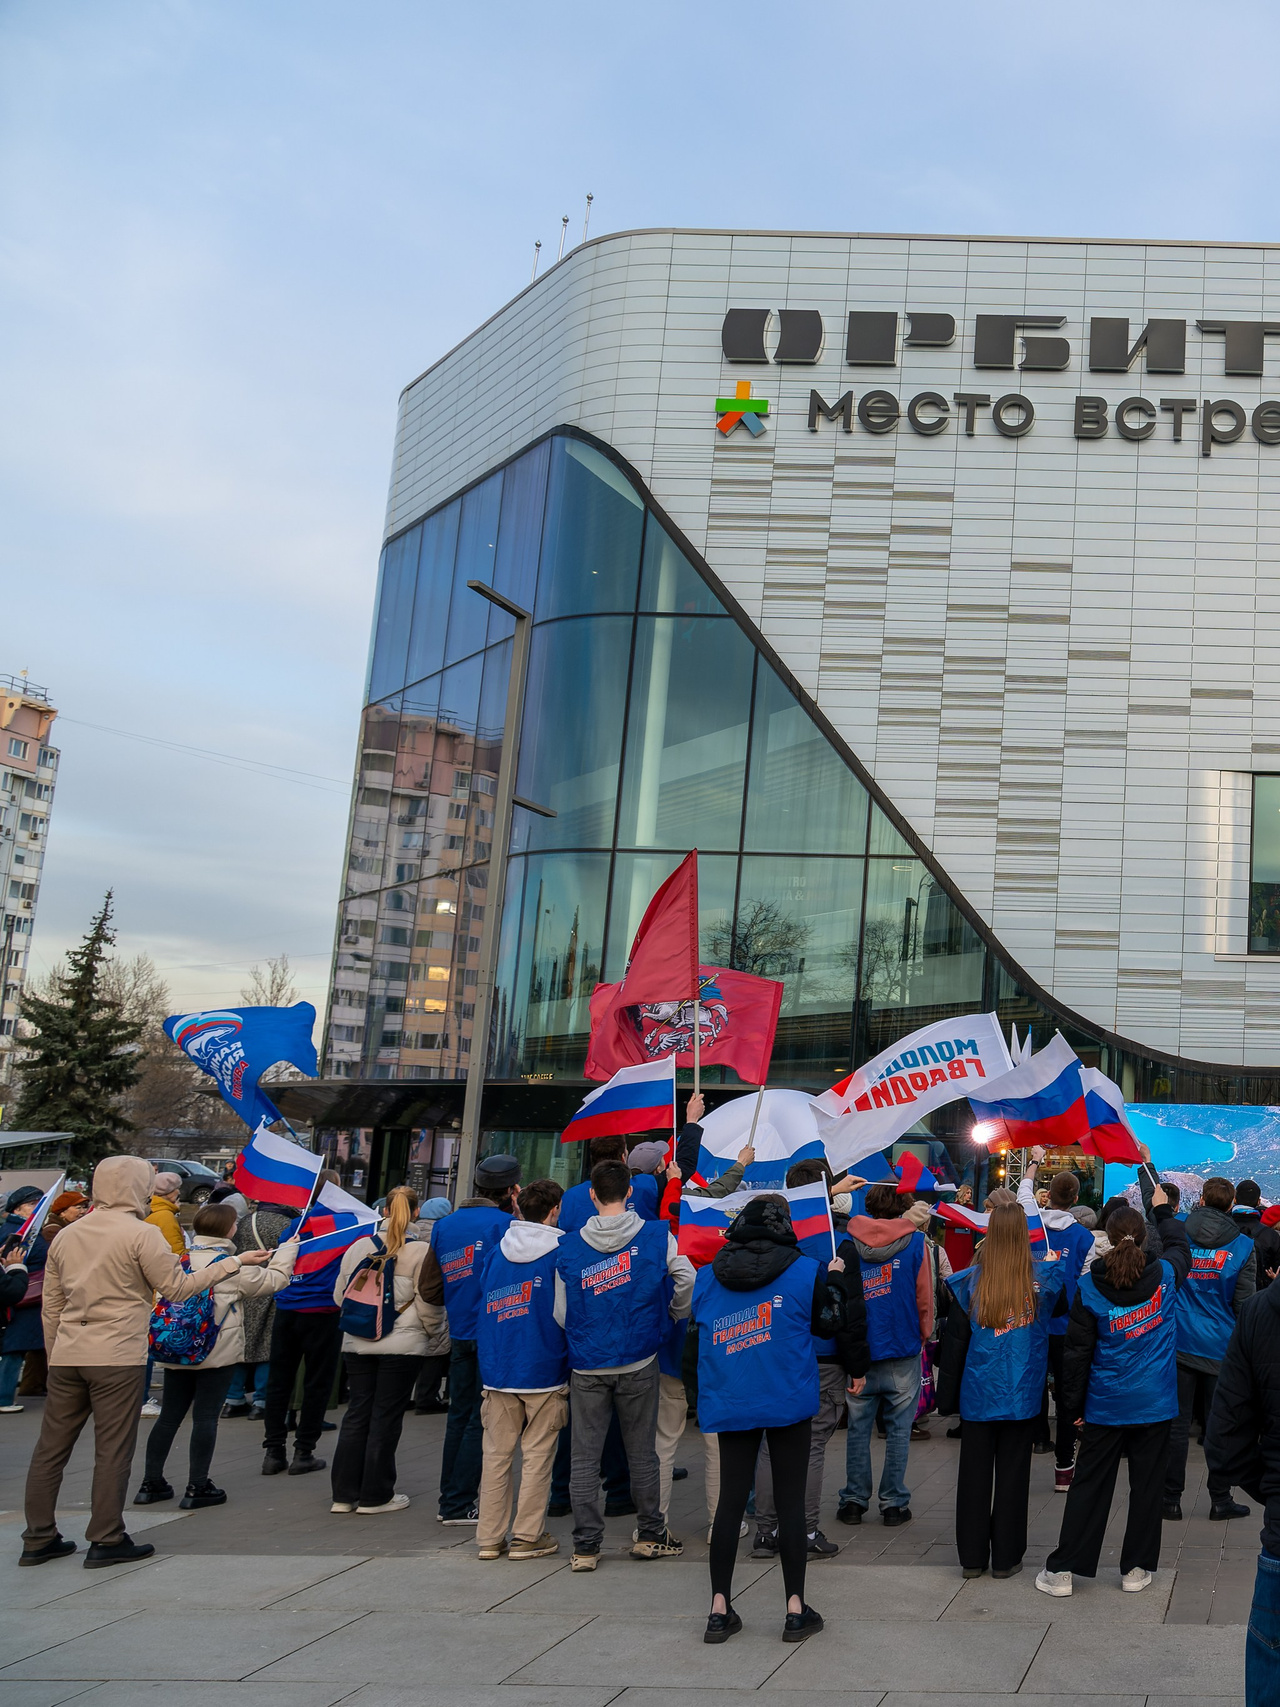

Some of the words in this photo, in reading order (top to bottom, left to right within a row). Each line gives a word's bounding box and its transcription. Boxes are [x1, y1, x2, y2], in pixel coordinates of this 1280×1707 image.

[594, 1273, 632, 1296] МОСКВА
[863, 1286, 892, 1301] ОСКВА
[713, 1301, 772, 1332] МОЛОДАЯ
[713, 1304, 772, 1345] ГВАРДИЯ
[1125, 1315, 1163, 1340] МОСКВА
[726, 1331, 772, 1355] МОСКВА
